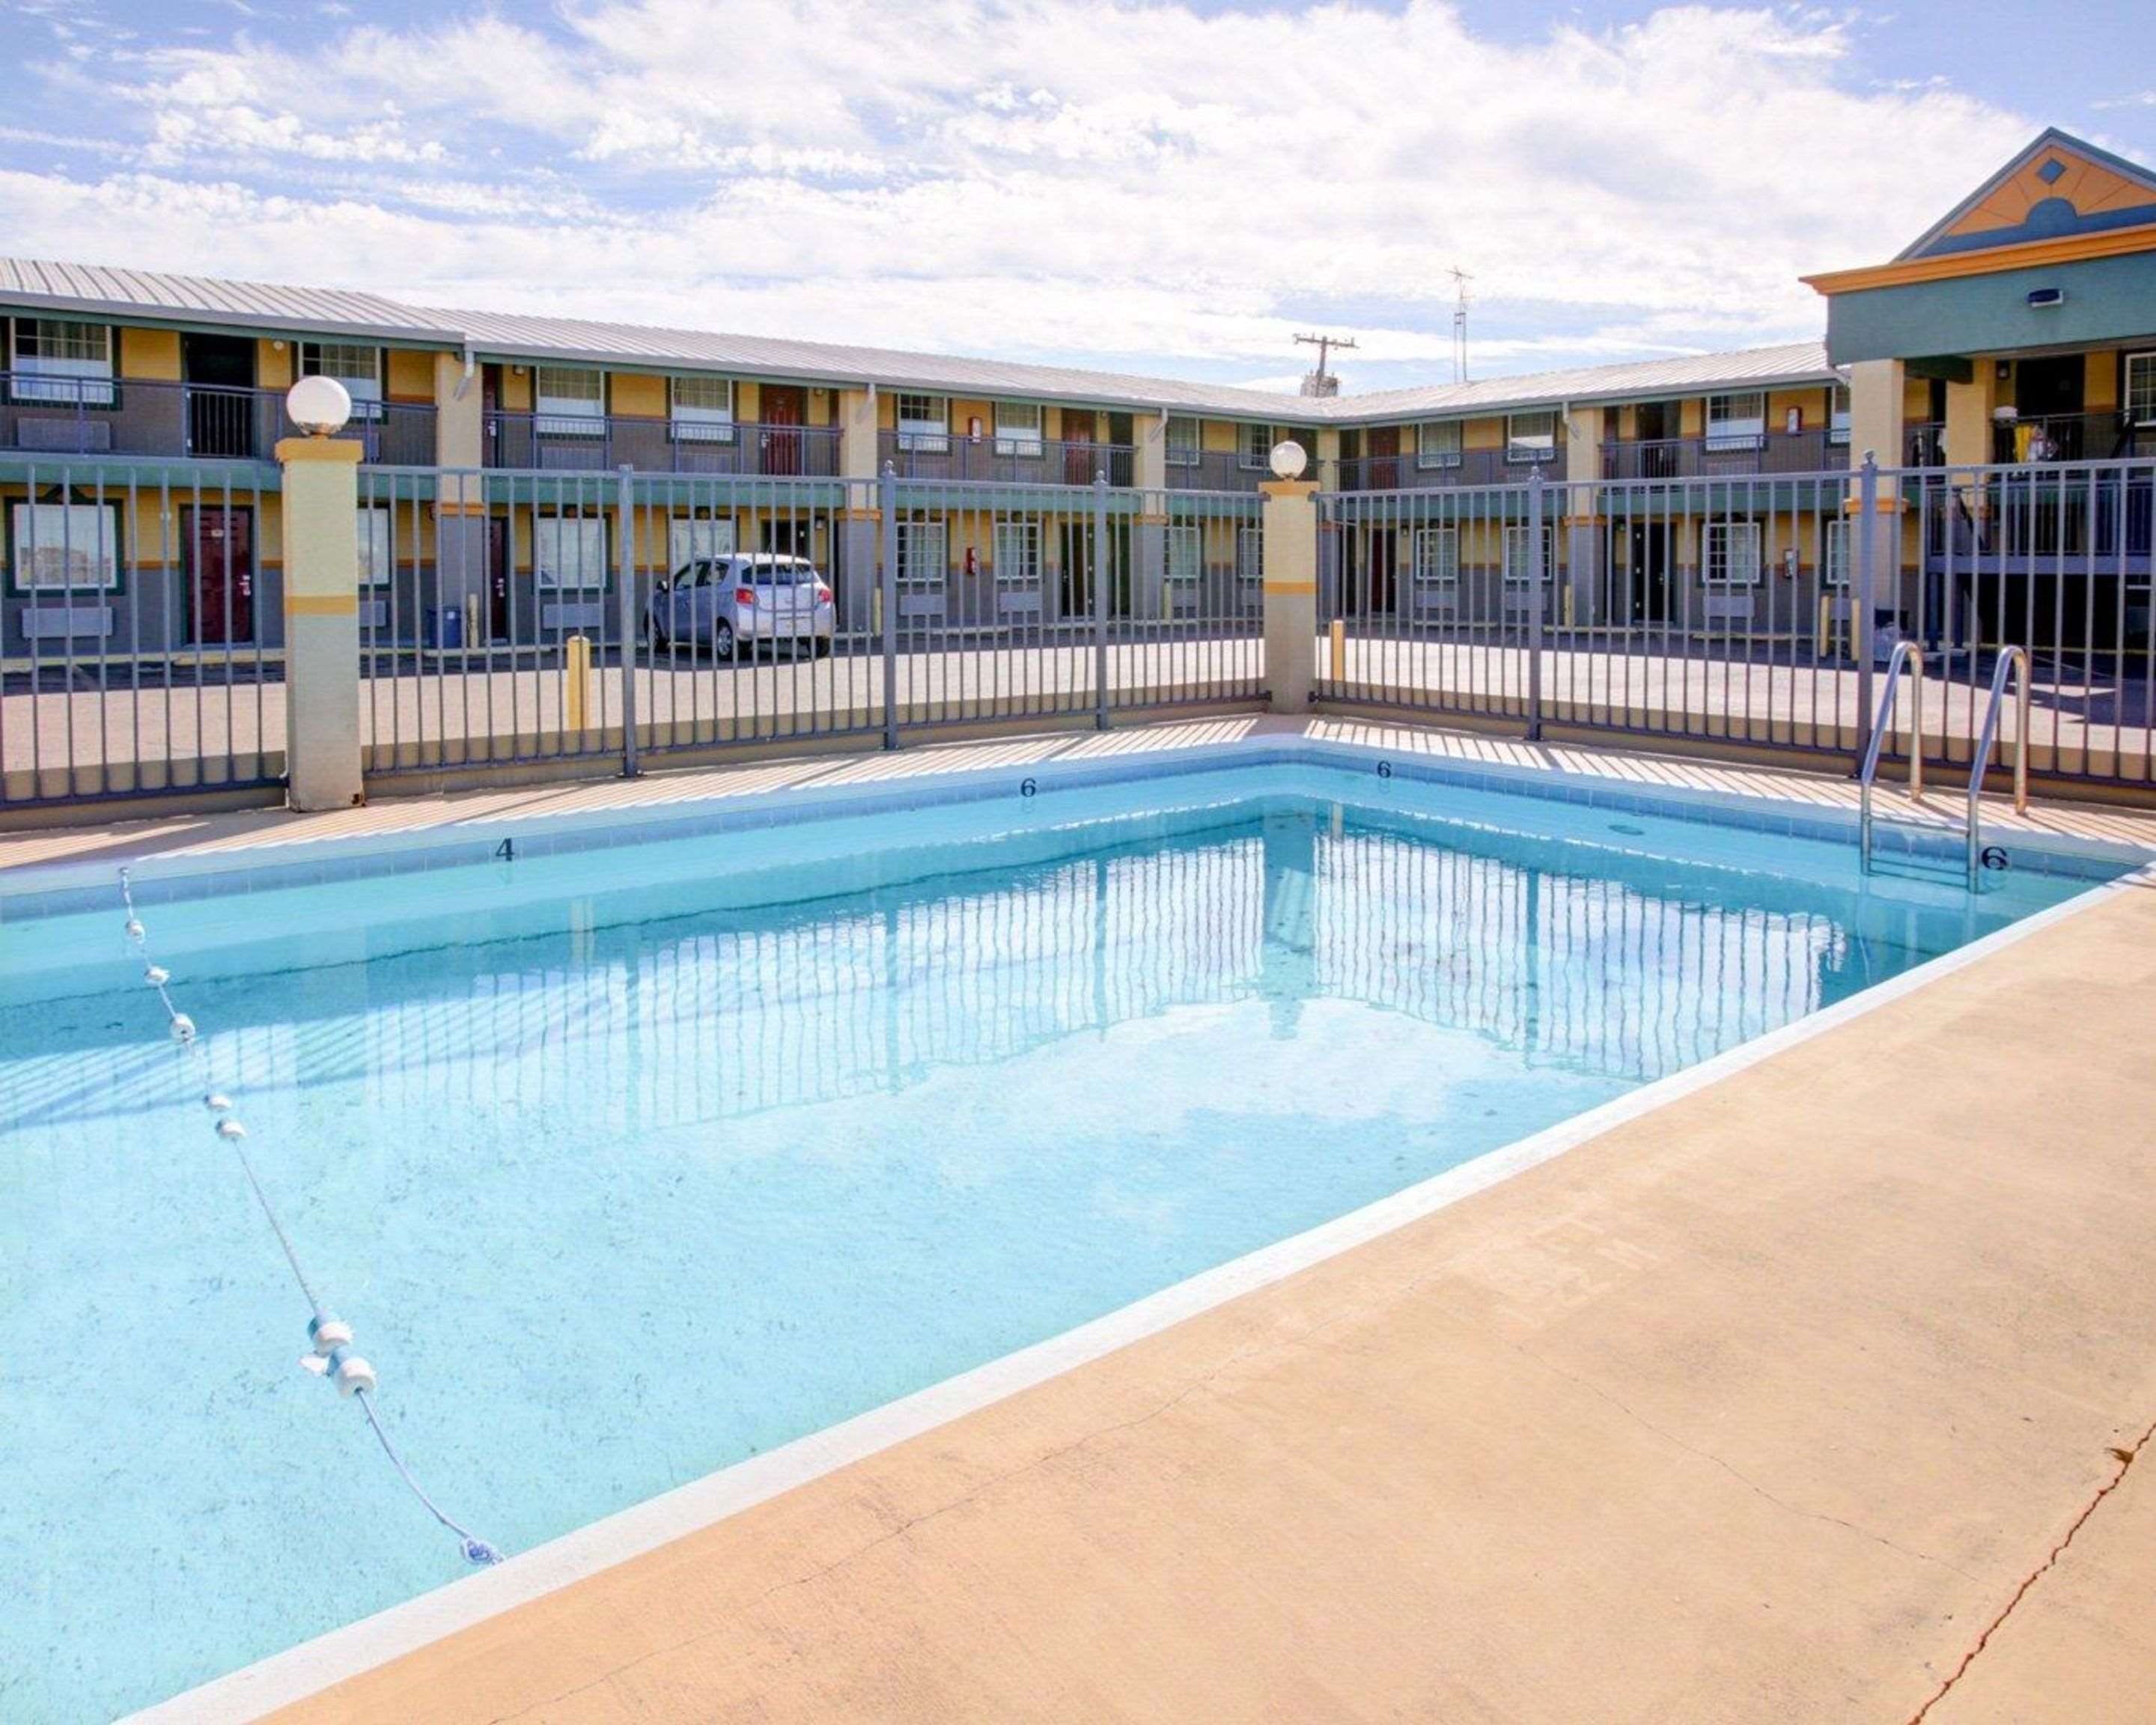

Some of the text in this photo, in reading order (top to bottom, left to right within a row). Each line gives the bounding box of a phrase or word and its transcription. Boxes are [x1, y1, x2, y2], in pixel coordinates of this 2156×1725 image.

[1377, 760, 1392, 779] 6
[1020, 777, 1037, 797] 6
[495, 837, 516, 862] 4
[1981, 845, 2009, 871] 6
